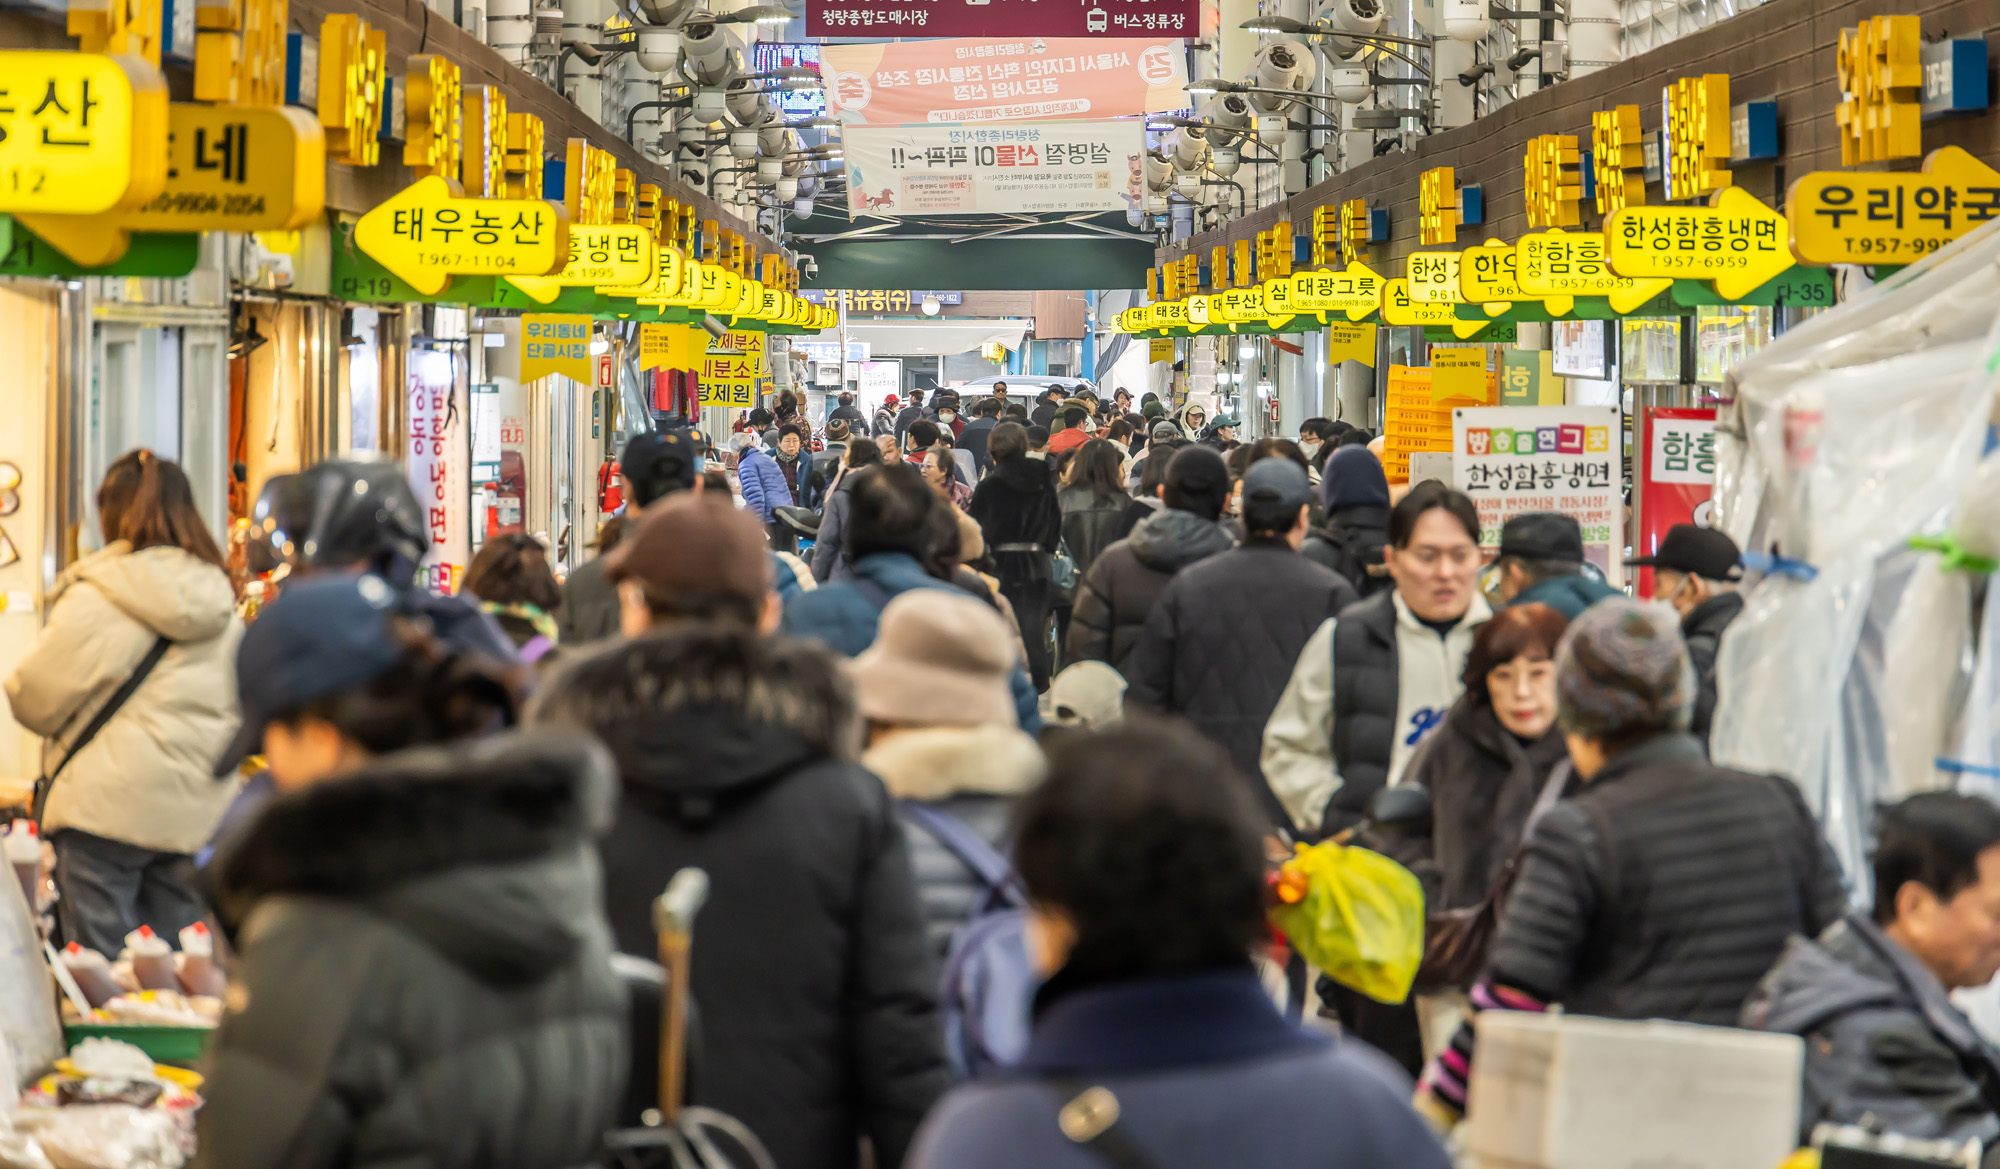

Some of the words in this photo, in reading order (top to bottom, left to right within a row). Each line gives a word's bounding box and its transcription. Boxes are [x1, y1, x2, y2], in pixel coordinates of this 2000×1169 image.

[822, 9, 928, 26] 청량종합도매시장
[1113, 13, 1185, 30] 버스정류장
[394, 207, 543, 245] 태우농산
[1622, 216, 1776, 252] 한성함흥냉면
[417, 253, 515, 268] T.967-1104
[1651, 254, 1748, 269] T.957-6959
[581, 268, 615, 278] 1995
[342, 278, 391, 297] 다-19
[1297, 277, 1376, 297] 대광그릇
[1549, 277, 1634, 289] T.957-6959
[1776, 281, 1825, 302] 다-35
[526, 322, 587, 339] 우리동네
[526, 342, 586, 360] 단골시장
[1502, 365, 1531, 397] 한
[1465, 461, 1609, 491] 한성함흥냉면
